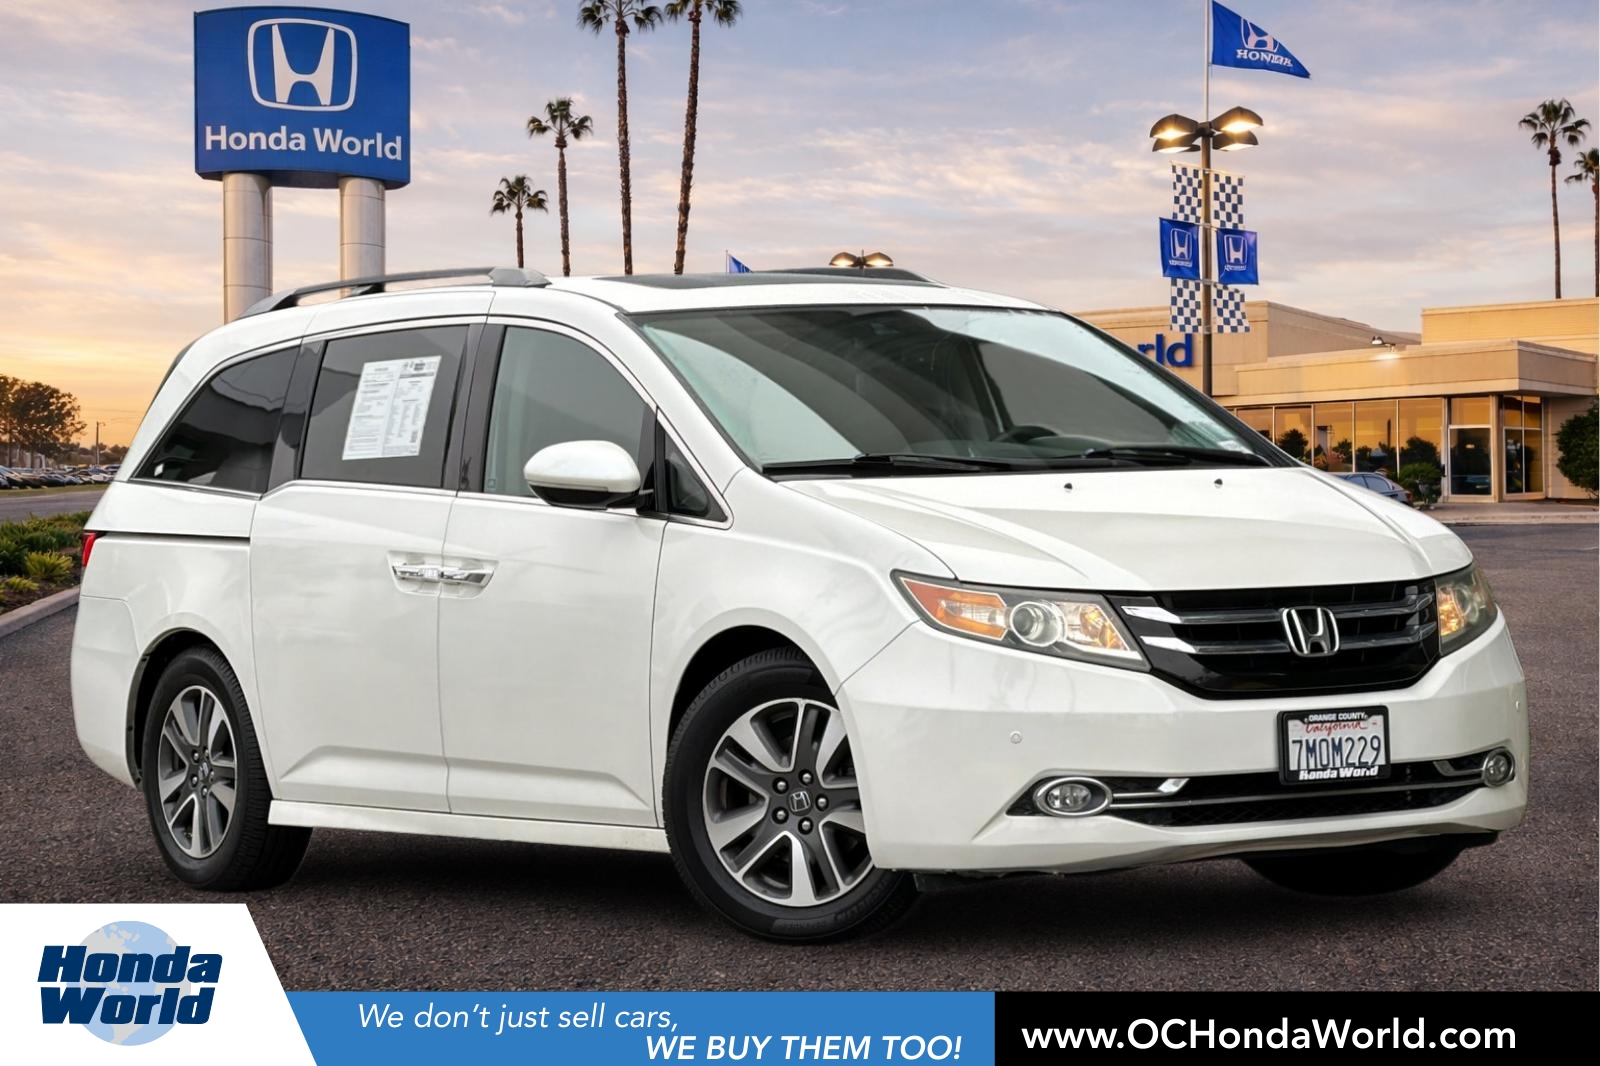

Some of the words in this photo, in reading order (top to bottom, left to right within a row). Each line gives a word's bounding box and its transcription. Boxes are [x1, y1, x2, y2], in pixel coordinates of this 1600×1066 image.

[205, 125, 306, 151] Honda
[313, 127, 402, 160] World
[1308, 714, 1337, 722] ORANGE
[1338, 712, 1365, 720] COUNTY
[1291, 735, 1381, 770] 7MOM229
[1299, 769, 1338, 780] Honda
